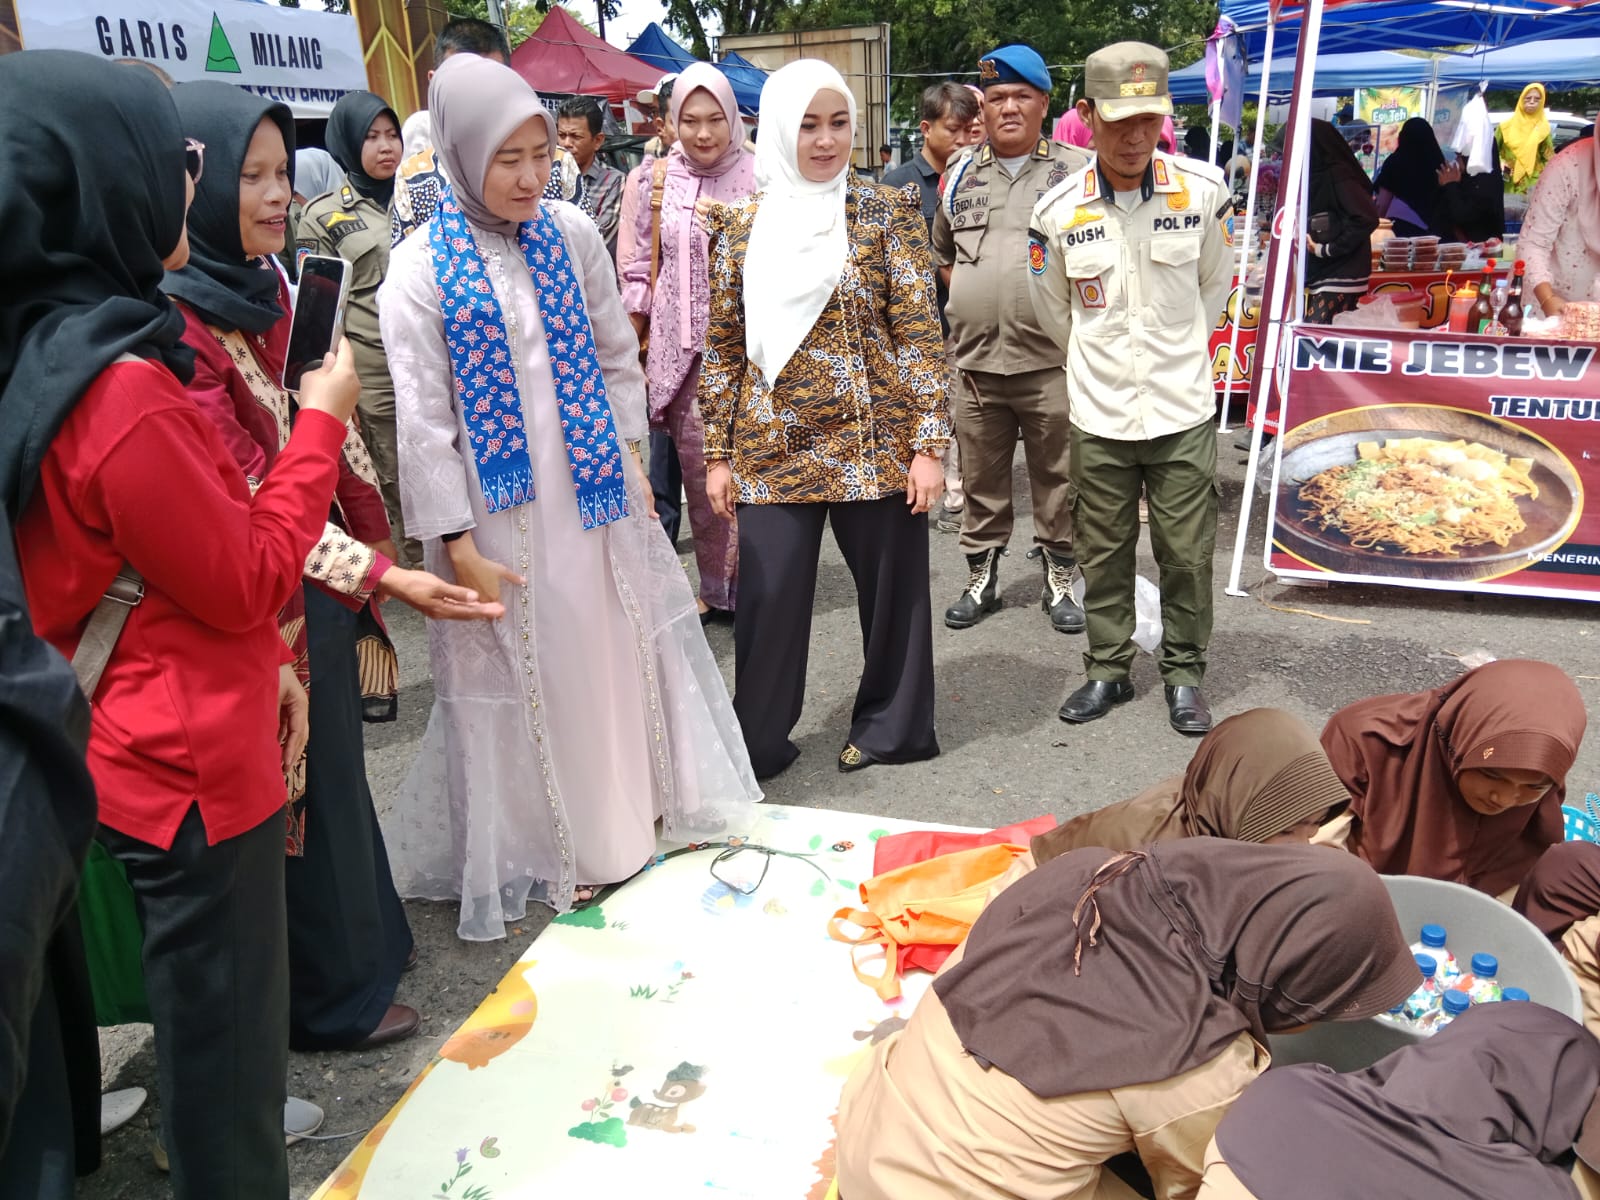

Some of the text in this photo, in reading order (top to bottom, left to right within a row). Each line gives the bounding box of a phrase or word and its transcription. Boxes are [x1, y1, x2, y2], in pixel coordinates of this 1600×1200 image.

[95, 15, 323, 70] GARIS MILANG
[1153, 215, 1200, 231] POL PP
[1295, 337, 1596, 380] MIE JEBEW
